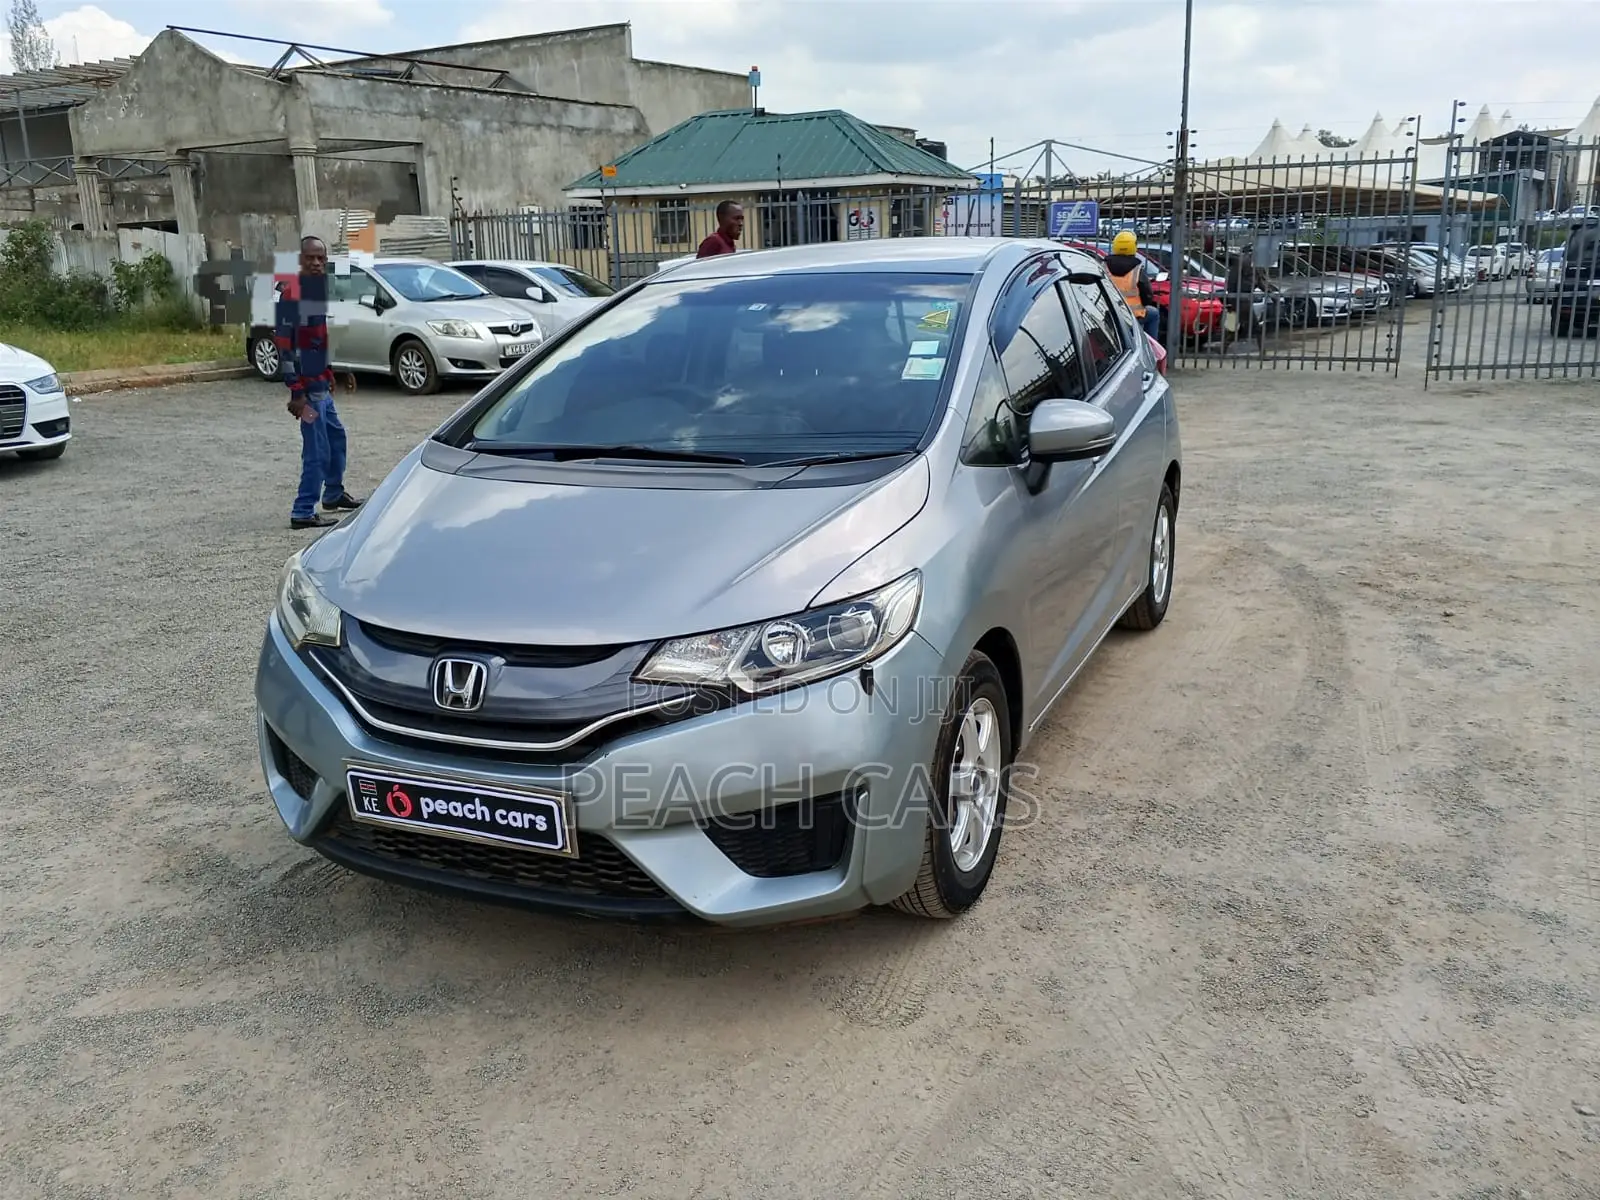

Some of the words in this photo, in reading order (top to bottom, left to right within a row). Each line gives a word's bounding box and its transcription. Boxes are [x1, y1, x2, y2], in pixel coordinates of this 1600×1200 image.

[362, 796, 381, 813] KE
[420, 797, 490, 821] peach
[495, 808, 548, 832] cars
